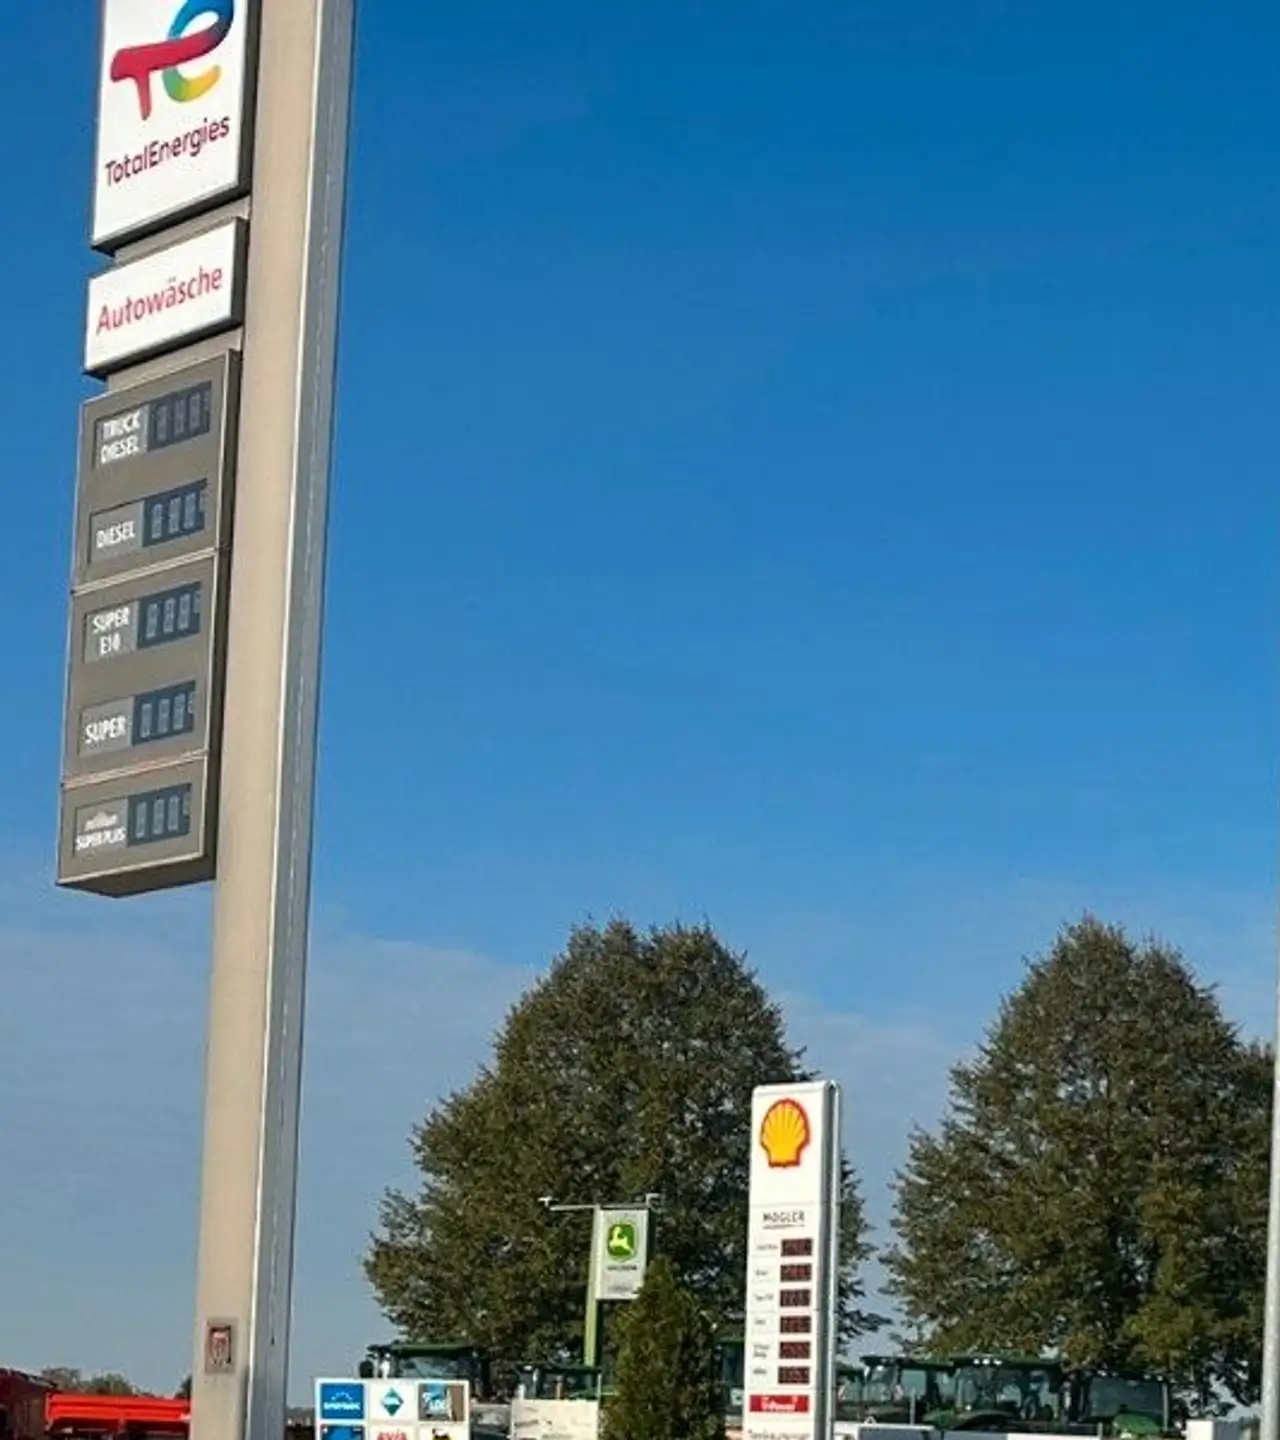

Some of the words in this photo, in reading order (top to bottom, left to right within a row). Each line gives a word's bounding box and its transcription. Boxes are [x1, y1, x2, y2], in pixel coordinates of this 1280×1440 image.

[104, 115, 231, 187] TotalEnergies
[96, 265, 223, 334] Autowäsche
[95, 520, 137, 549] DIESEL
[92, 606, 131, 635] SUPER
[84, 715, 127, 745] SUPER
